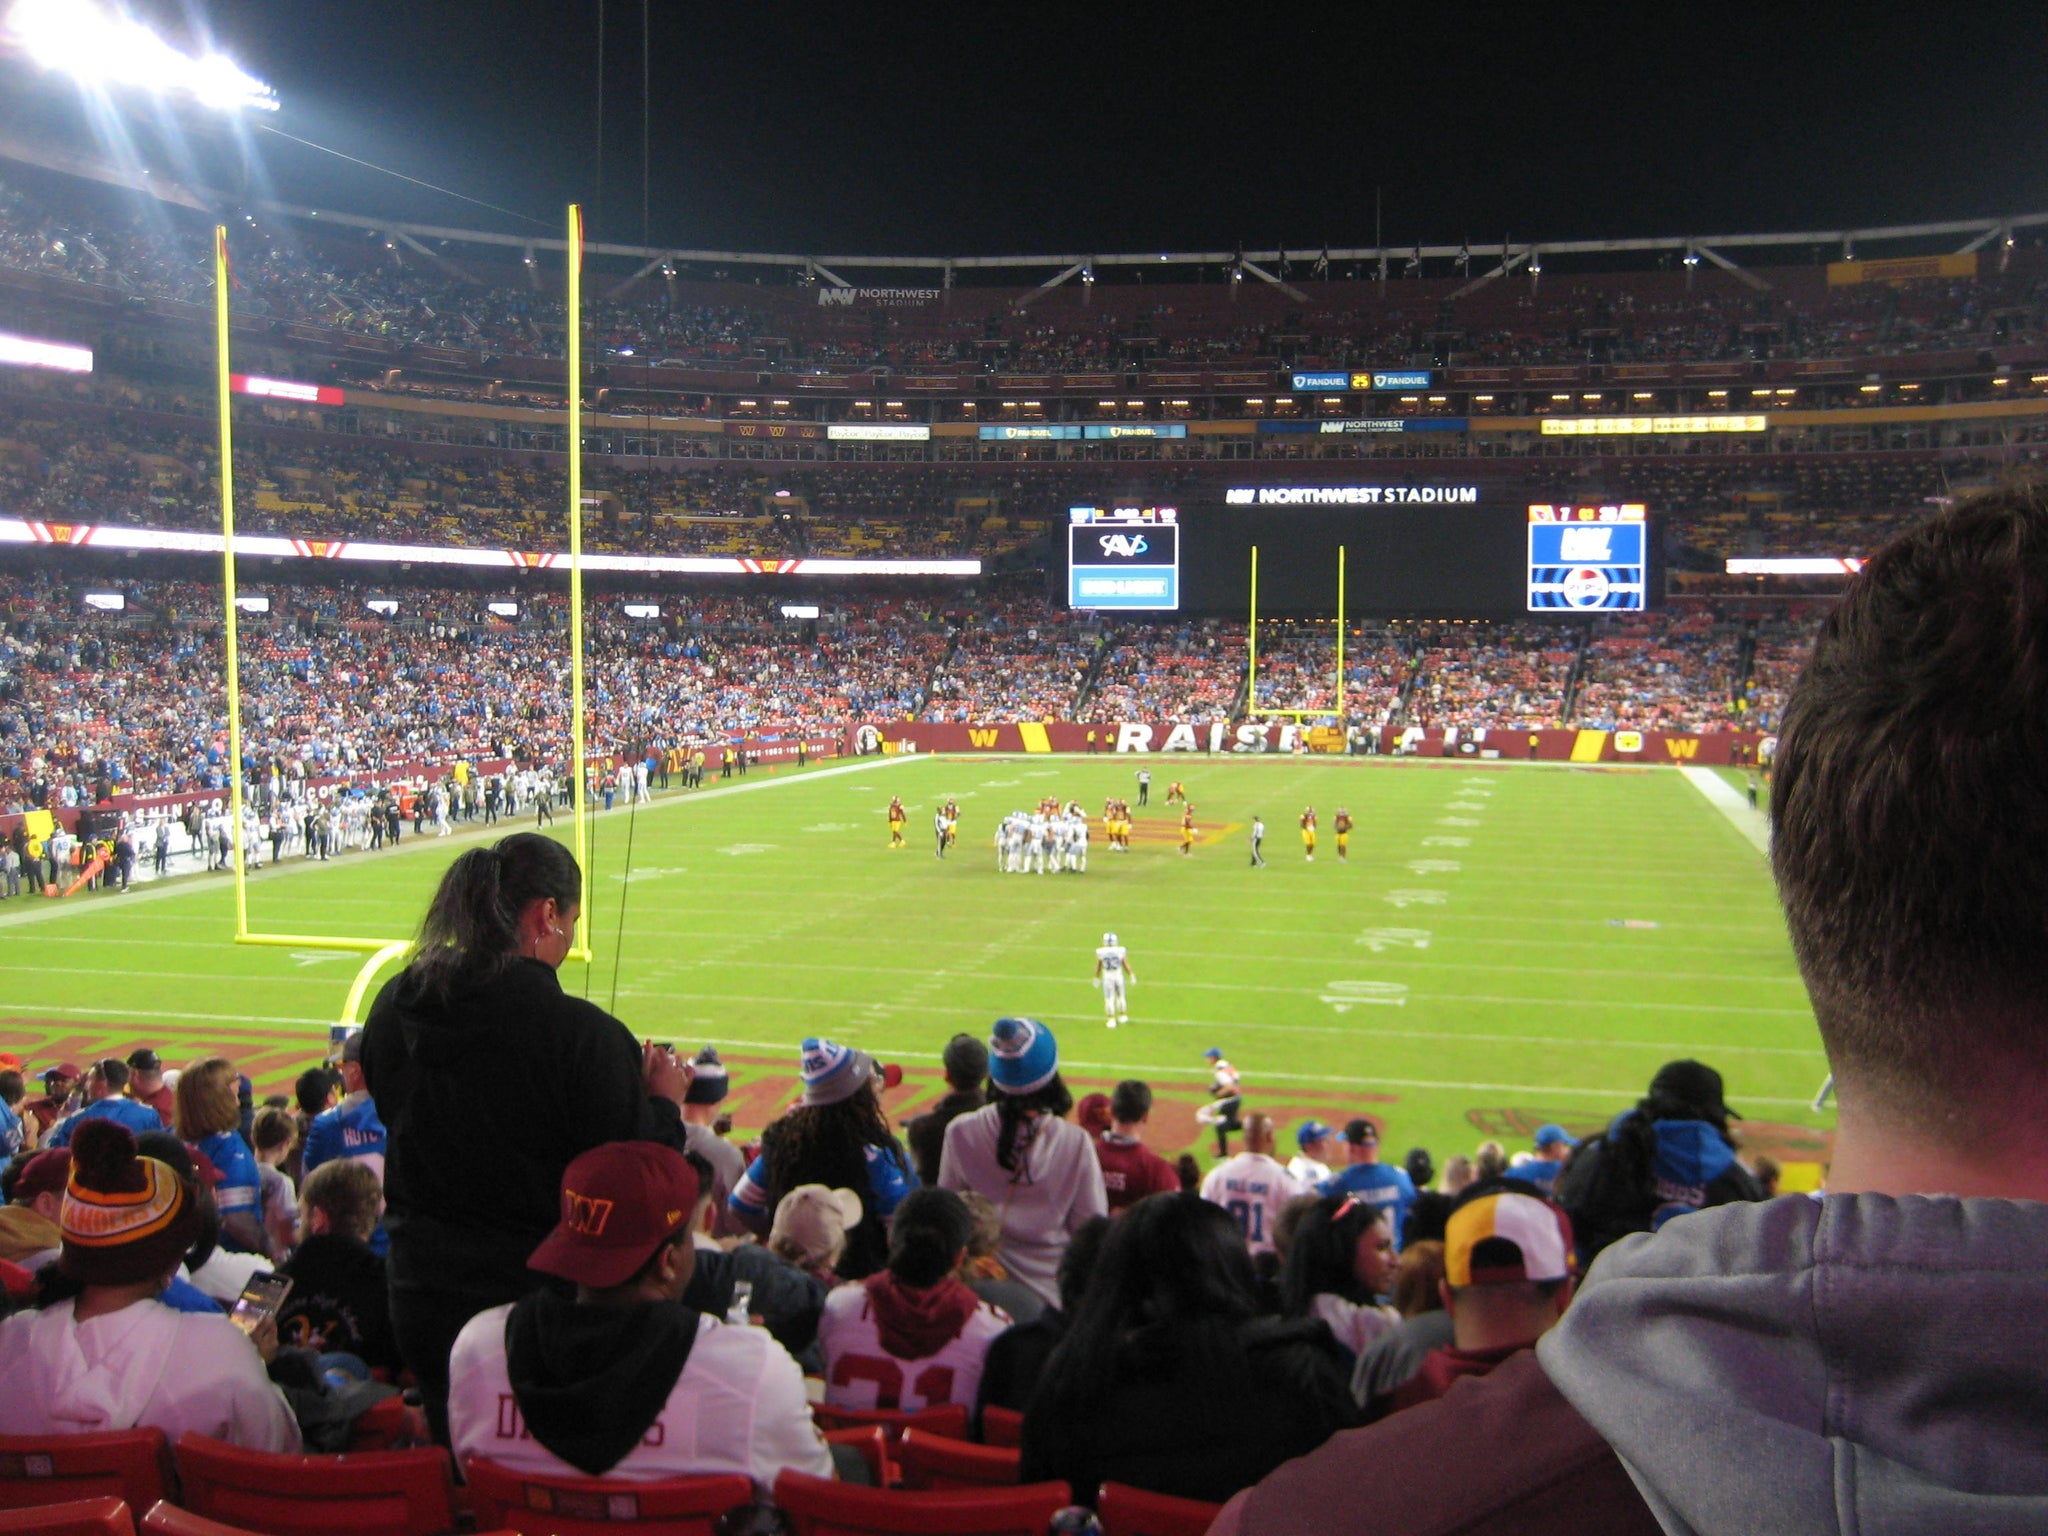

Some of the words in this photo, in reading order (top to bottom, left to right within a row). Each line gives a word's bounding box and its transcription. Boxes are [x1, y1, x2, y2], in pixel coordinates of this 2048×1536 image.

[859, 288, 941, 300] NORTHWEST
[876, 299, 925, 307] STADIUM
[1307, 377, 1346, 386] FANDUEL
[1387, 376, 1428, 385] FANDUEL
[1345, 420, 1405, 428] NORTHWEST
[1017, 429, 1052, 437] FANDUEL
[1122, 428, 1156, 436] FANDUEL
[1259, 488, 1382, 503] NORTHWEST
[1384, 487, 1477, 502] STADIUM
